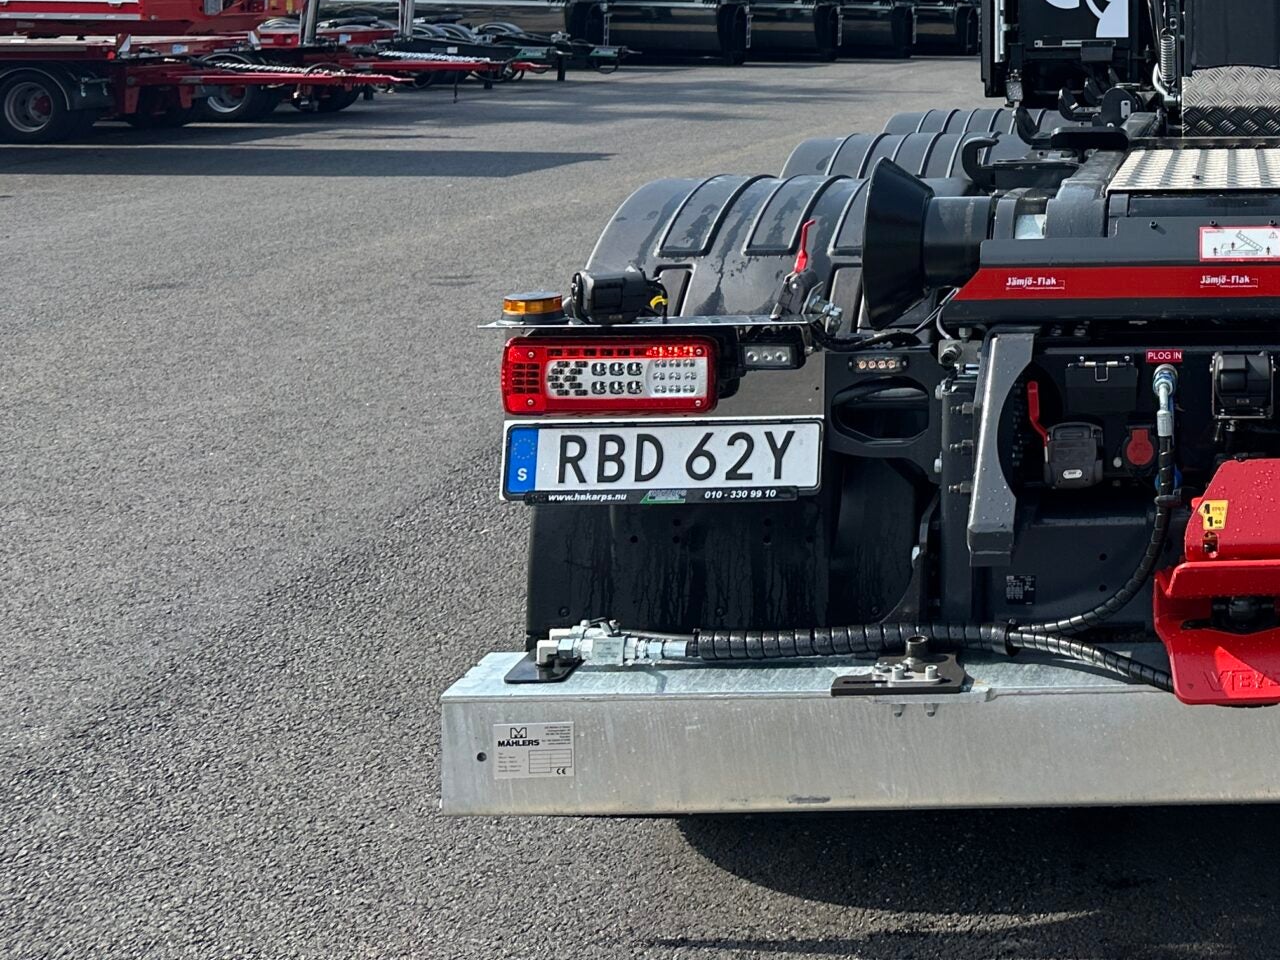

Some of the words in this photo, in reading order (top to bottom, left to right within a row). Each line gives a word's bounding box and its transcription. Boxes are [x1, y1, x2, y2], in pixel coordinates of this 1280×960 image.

[1006, 277, 1057, 288] Jämjö-Flak
[1200, 274, 1250, 286] Jämjö-Flak
[1147, 351, 1171, 360] PLOG
[1173, 351, 1182, 359] IN
[557, 433, 664, 484] RBD
[685, 431, 796, 481] 62Y
[517, 467, 528, 482] S
[548, 492, 628, 502] www.hakarps.nu
[704, 490, 722, 499] 010
[730, 490, 748, 498] 330
[750, 490, 762, 498] 99
[765, 489, 777, 497] 10
[497, 739, 540, 747] MÄHLERS
